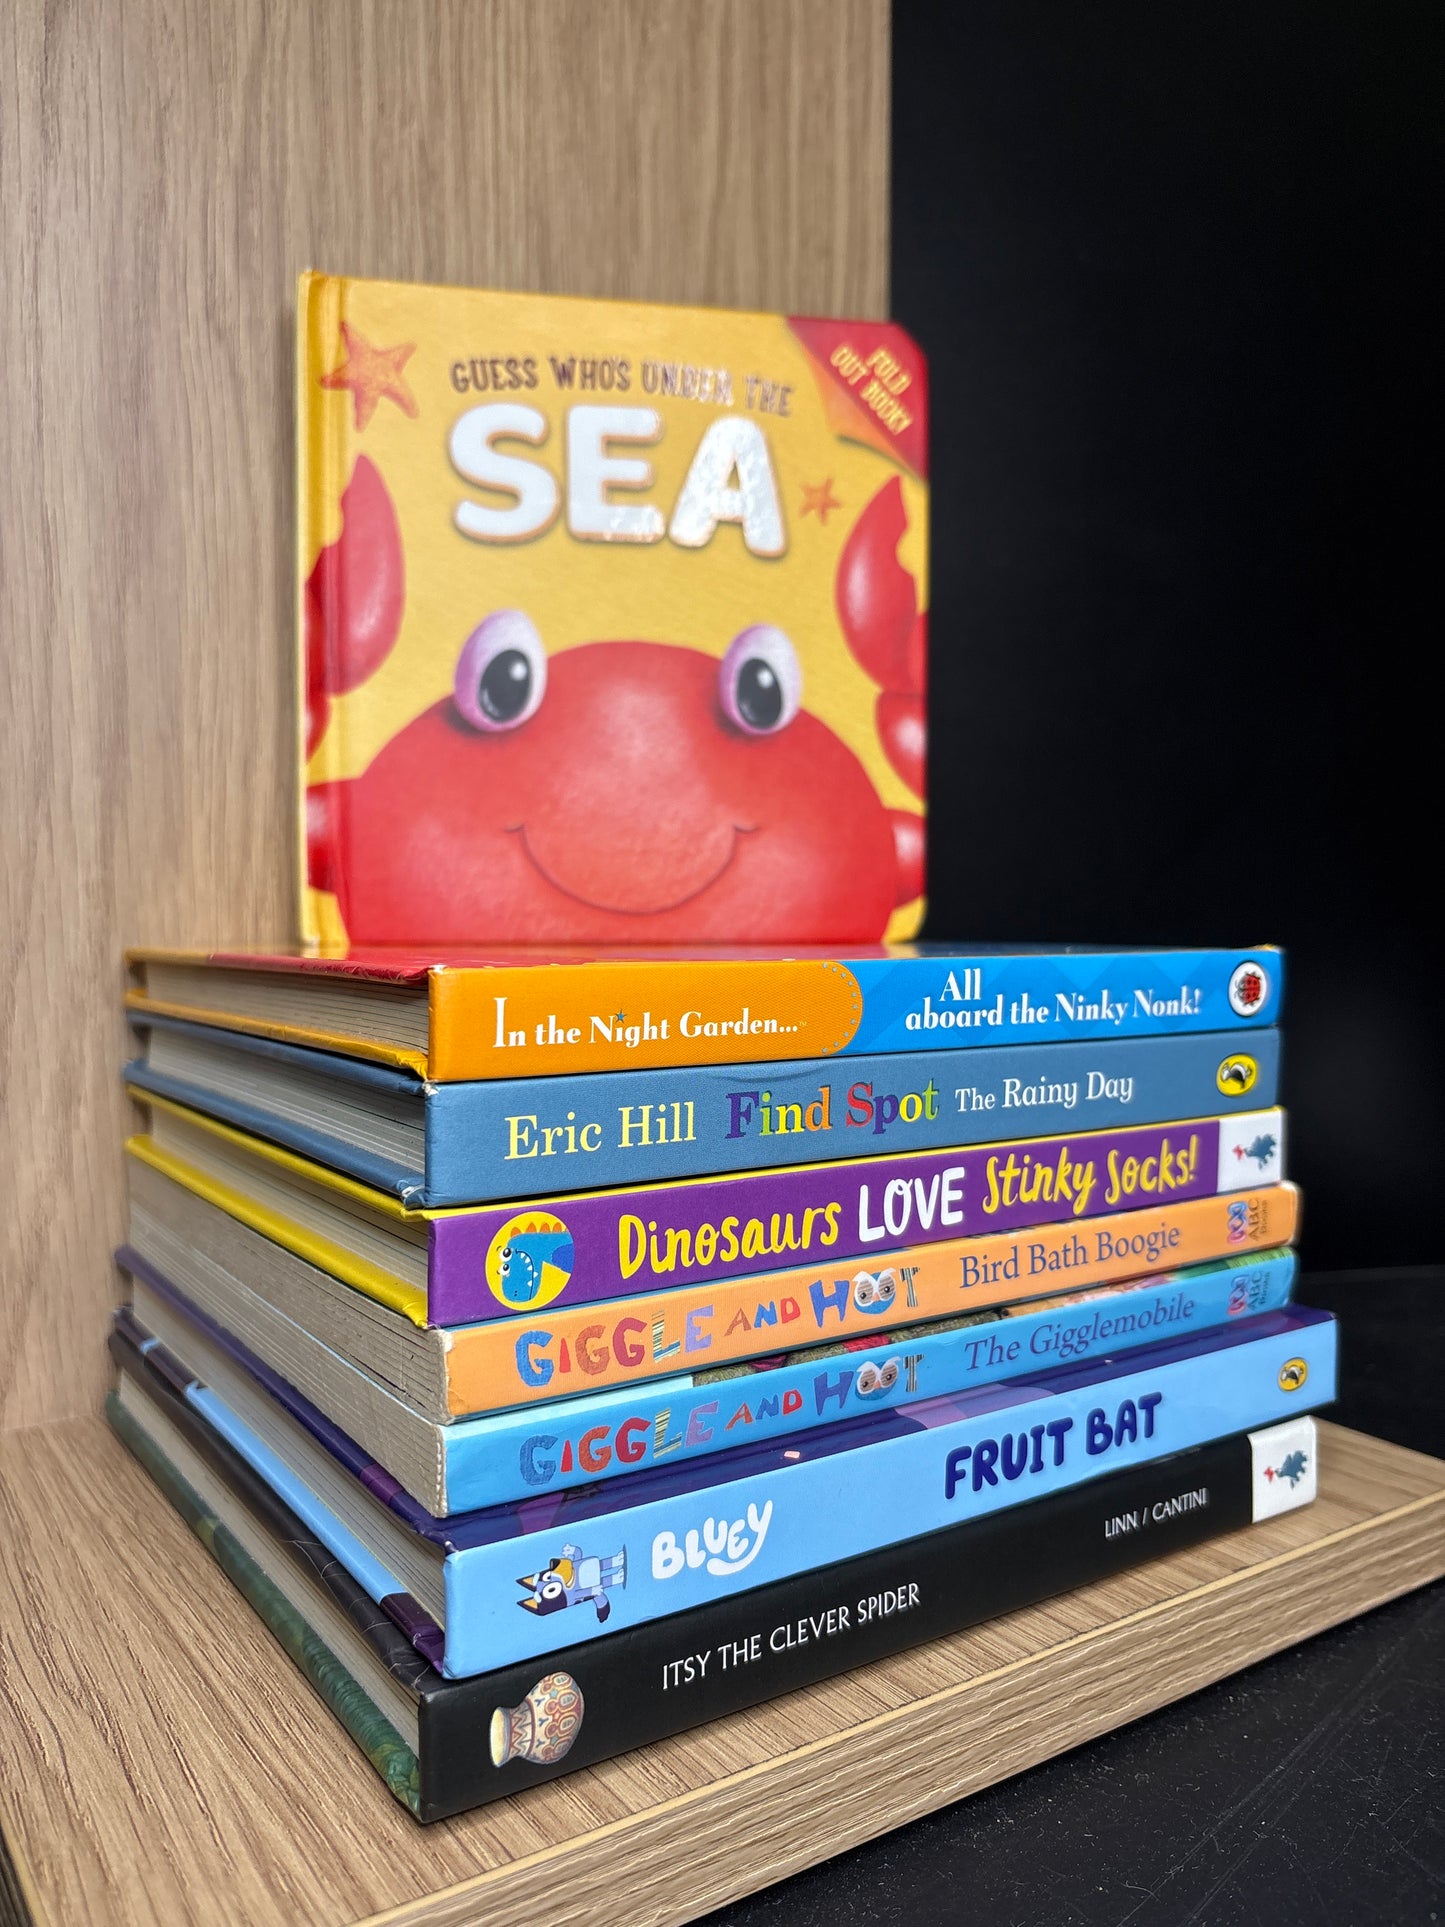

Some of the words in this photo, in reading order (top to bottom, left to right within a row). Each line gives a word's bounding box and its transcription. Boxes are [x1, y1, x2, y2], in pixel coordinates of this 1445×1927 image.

[451, 356, 538, 394] GUESS
[641, 358, 735, 407] UNDER
[745, 372, 795, 418] THE
[830, 344, 869, 387] OUT
[865, 346, 913, 396] FOLD
[449, 402, 787, 559] SEA
[492, 996, 526, 1049] In
[535, 1013, 582, 1045] the
[588, 1010, 671, 1049] Night
[679, 1007, 799, 1039] Garden...
[905, 996, 1003, 1031] aboard
[1009, 997, 1050, 1025] the
[1054, 991, 1126, 1026] Ninky
[1132, 986, 1203, 1019] Nonk!
[939, 967, 982, 1002] All
[503, 1111, 602, 1161] Eric
[616, 1101, 697, 1149] Hill
[724, 1085, 832, 1140] Find
[845, 1077, 940, 1135] Spot
[954, 1087, 997, 1114] The
[1000, 1074, 1079, 1110] Rainy
[1084, 1070, 1135, 1102] Day
[617, 1201, 843, 1280] Dinosaurs
[858, 1165, 966, 1244] LOVE
[981, 1145, 1097, 1216] Stinky
[1104, 1133, 1201, 1206] Socks!
[1248, 1198, 1260, 1241] ABC
[515, 1303, 715, 1389] GIGGLE
[724, 1295, 802, 1338] AND
[959, 1245, 1020, 1290] Bird
[1027, 1234, 1089, 1276] Bath
[1093, 1223, 1181, 1265] Boogie
[518, 1399, 722, 1487] GIGGLE
[724, 1388, 804, 1432] AND
[964, 1333, 1021, 1371] The
[1029, 1291, 1195, 1359] Gigglemobile
[651, 1499, 774, 1581] BLUEY
[944, 1415, 1074, 1501] FRUIT
[1085, 1390, 1163, 1457] BAT
[661, 1649, 713, 1692] ITSY
[717, 1630, 763, 1668] THE
[768, 1607, 852, 1654] CLEVER
[856, 1581, 922, 1626] SPIDER
[1104, 1512, 1140, 1539] LINN
[1151, 1486, 1209, 1521] CANTINI
